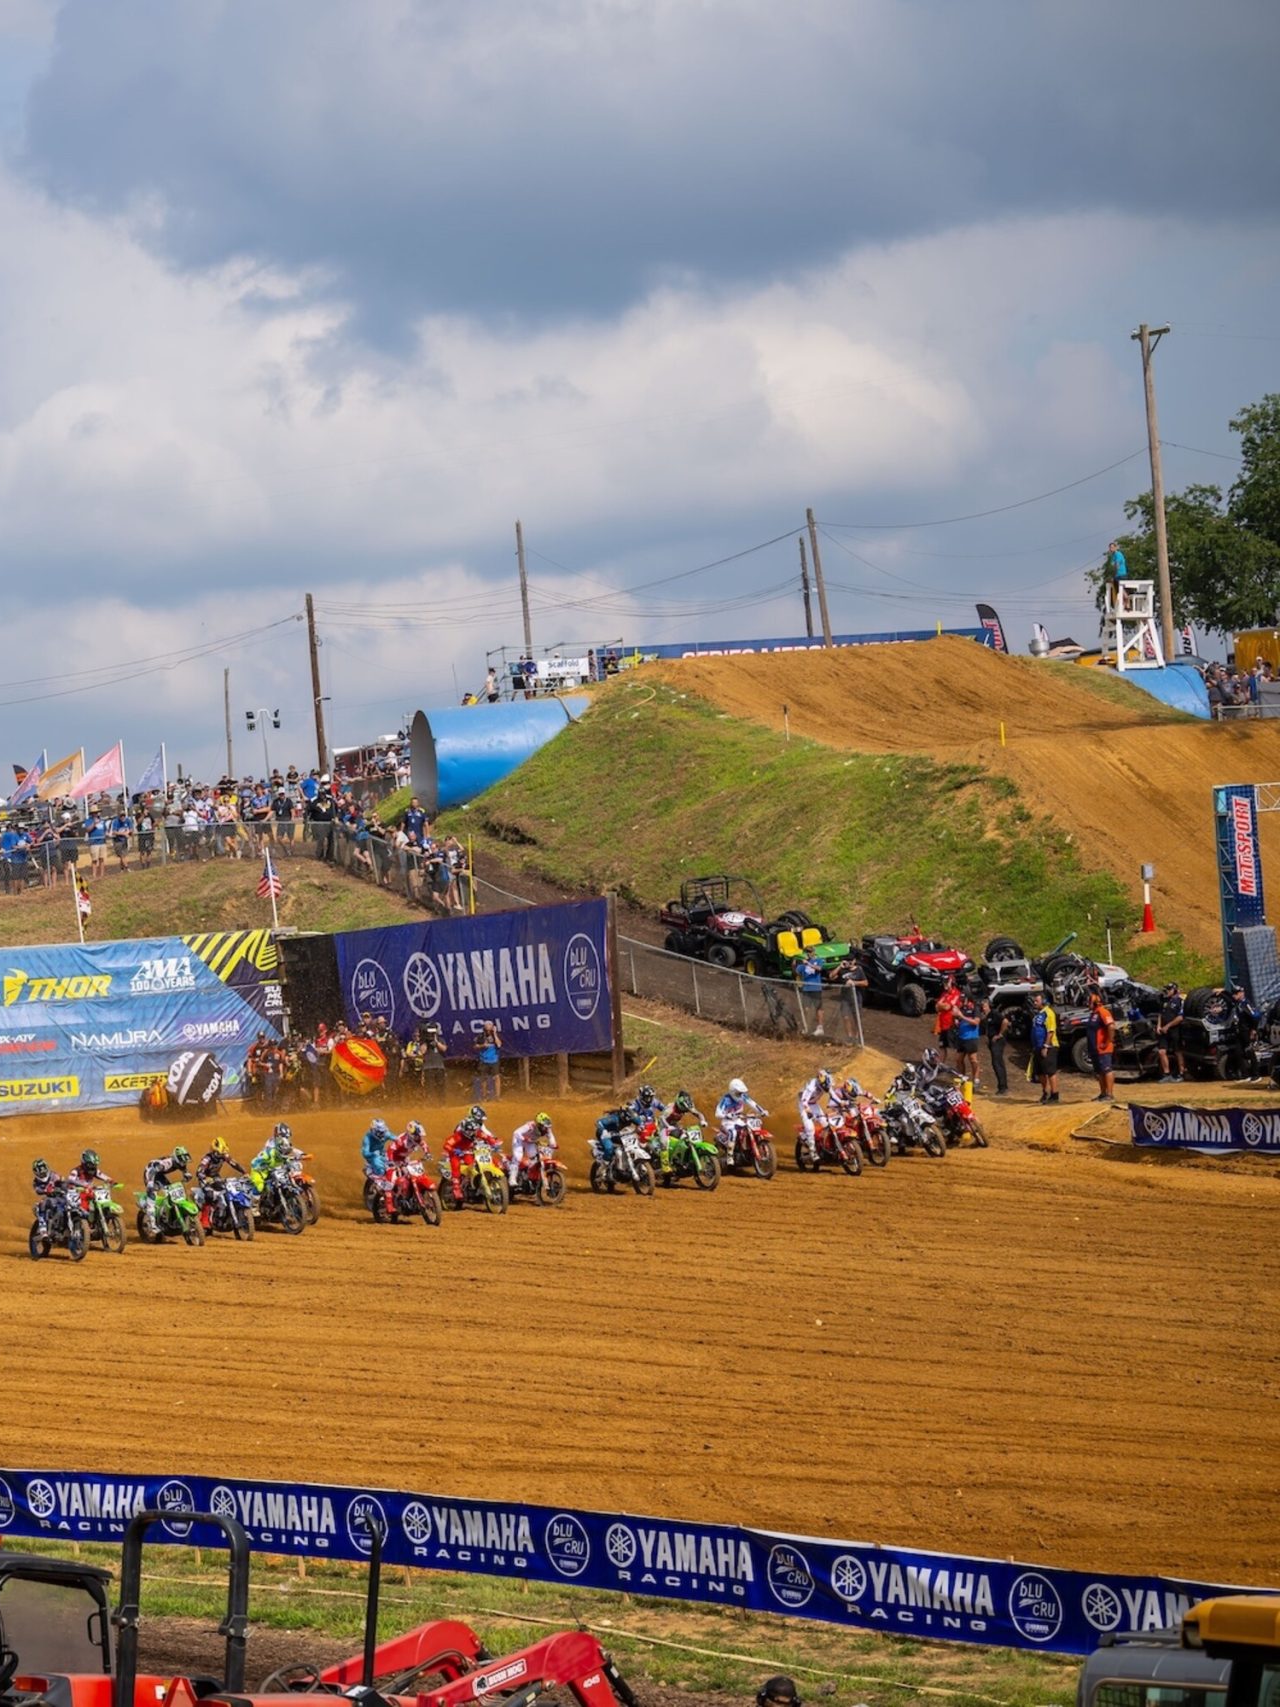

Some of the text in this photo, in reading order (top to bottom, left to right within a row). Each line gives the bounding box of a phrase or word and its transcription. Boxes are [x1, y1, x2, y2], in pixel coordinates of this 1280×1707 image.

[135, 957, 193, 981] AMA
[162, 975, 195, 989] YEARS
[437, 943, 556, 1011] YAMAHA
[28, 975, 112, 1001] THOR
[71, 1029, 163, 1047] NAMURA
[195, 1020, 240, 1036] YAMAHA
[832, 1116, 841, 1126] 7
[1166, 1110, 1232, 1143] YAMAHA
[55, 1481, 146, 1520] YAMAHA
[237, 1490, 336, 1534] YAMAHA
[39, 1519, 124, 1533] RACIN
[432, 1506, 535, 1554] YAMAHA
[414, 1546, 527, 1568] RACING
[637, 1529, 754, 1582] YAMAHA
[618, 1570, 745, 1596] RACING
[868, 1561, 995, 1616] YAMAHA
[847, 1603, 987, 1631] RACING
